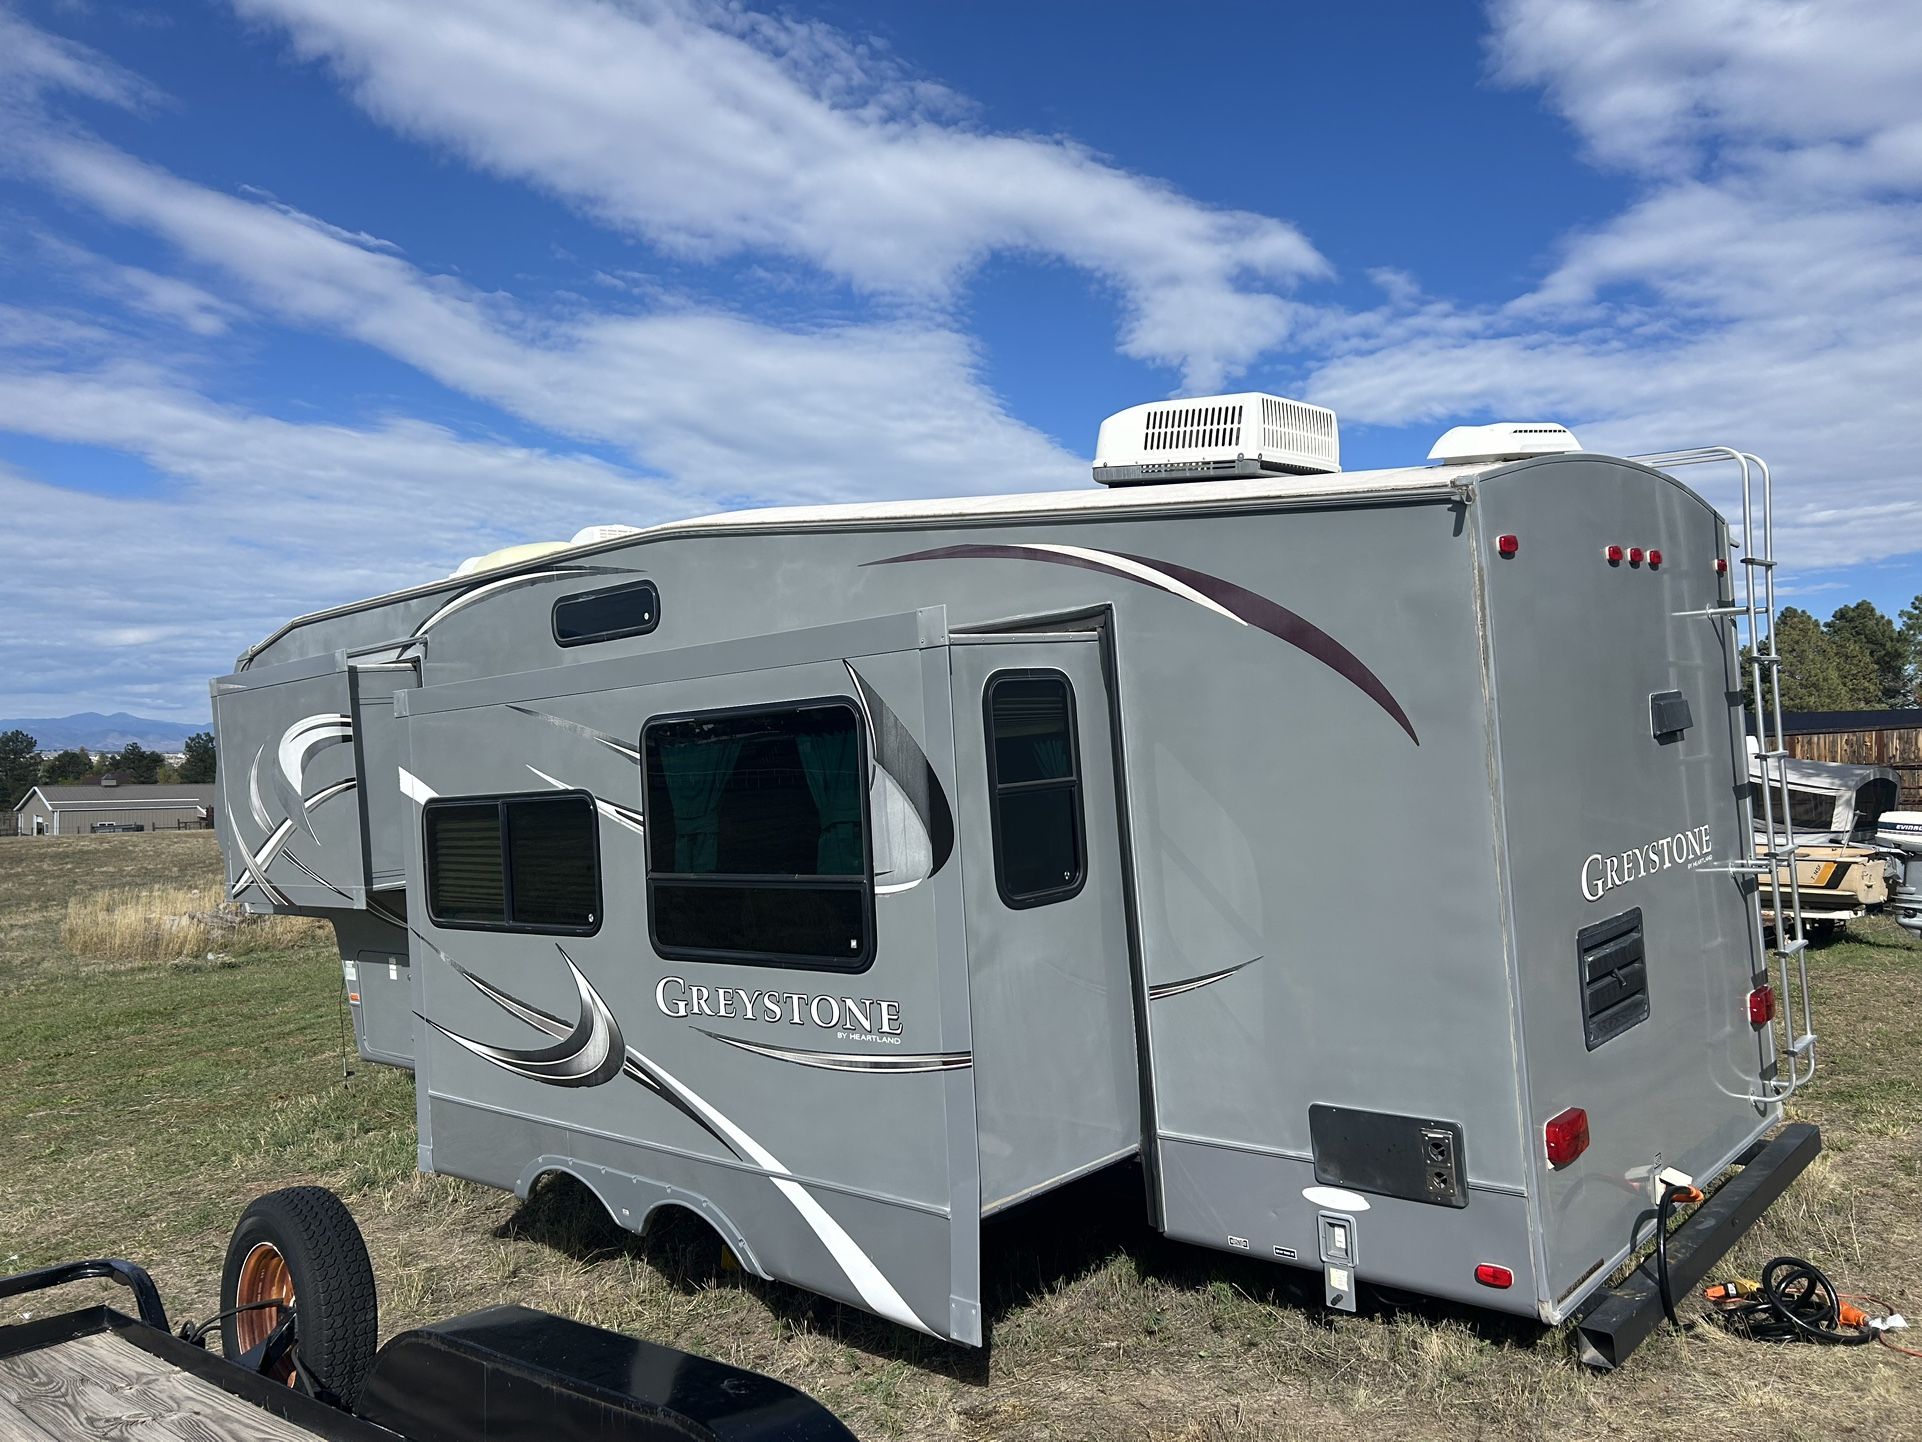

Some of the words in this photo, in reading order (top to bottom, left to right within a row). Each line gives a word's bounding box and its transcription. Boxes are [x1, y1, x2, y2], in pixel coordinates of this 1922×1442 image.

[1581, 825, 1712, 902] GREYSTONE
[655, 976, 904, 1034] GREYSTONE
[837, 1031, 848, 1039] BY
[849, 1033, 901, 1045] HEARTLAND
